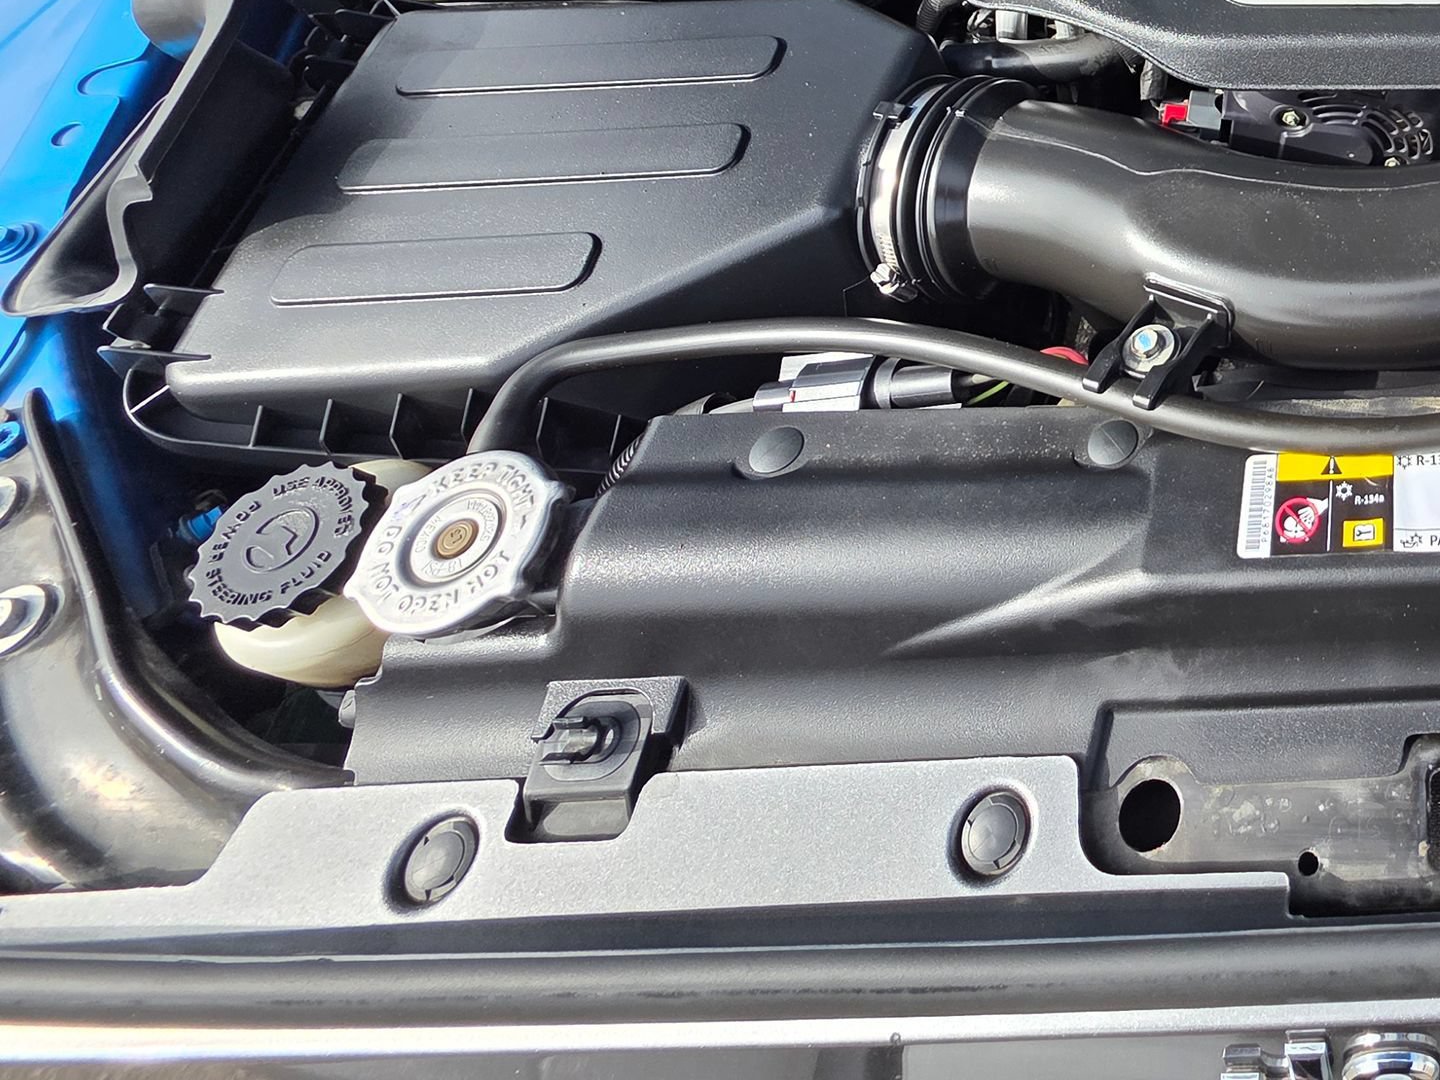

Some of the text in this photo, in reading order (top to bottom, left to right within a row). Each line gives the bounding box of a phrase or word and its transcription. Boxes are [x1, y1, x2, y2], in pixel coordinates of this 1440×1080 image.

[273, 477, 310, 497] USE
[432, 462, 537, 514] KEEP TIGHT
[1354, 494, 1385, 505] R-134a
[208, 501, 262, 563] POWER
[377, 525, 403, 555] DO
[205, 568, 274, 606] STEERING
[280, 550, 333, 595] FLUID
[368, 561, 400, 603] NOT
[398, 588, 460, 615] OPEN
